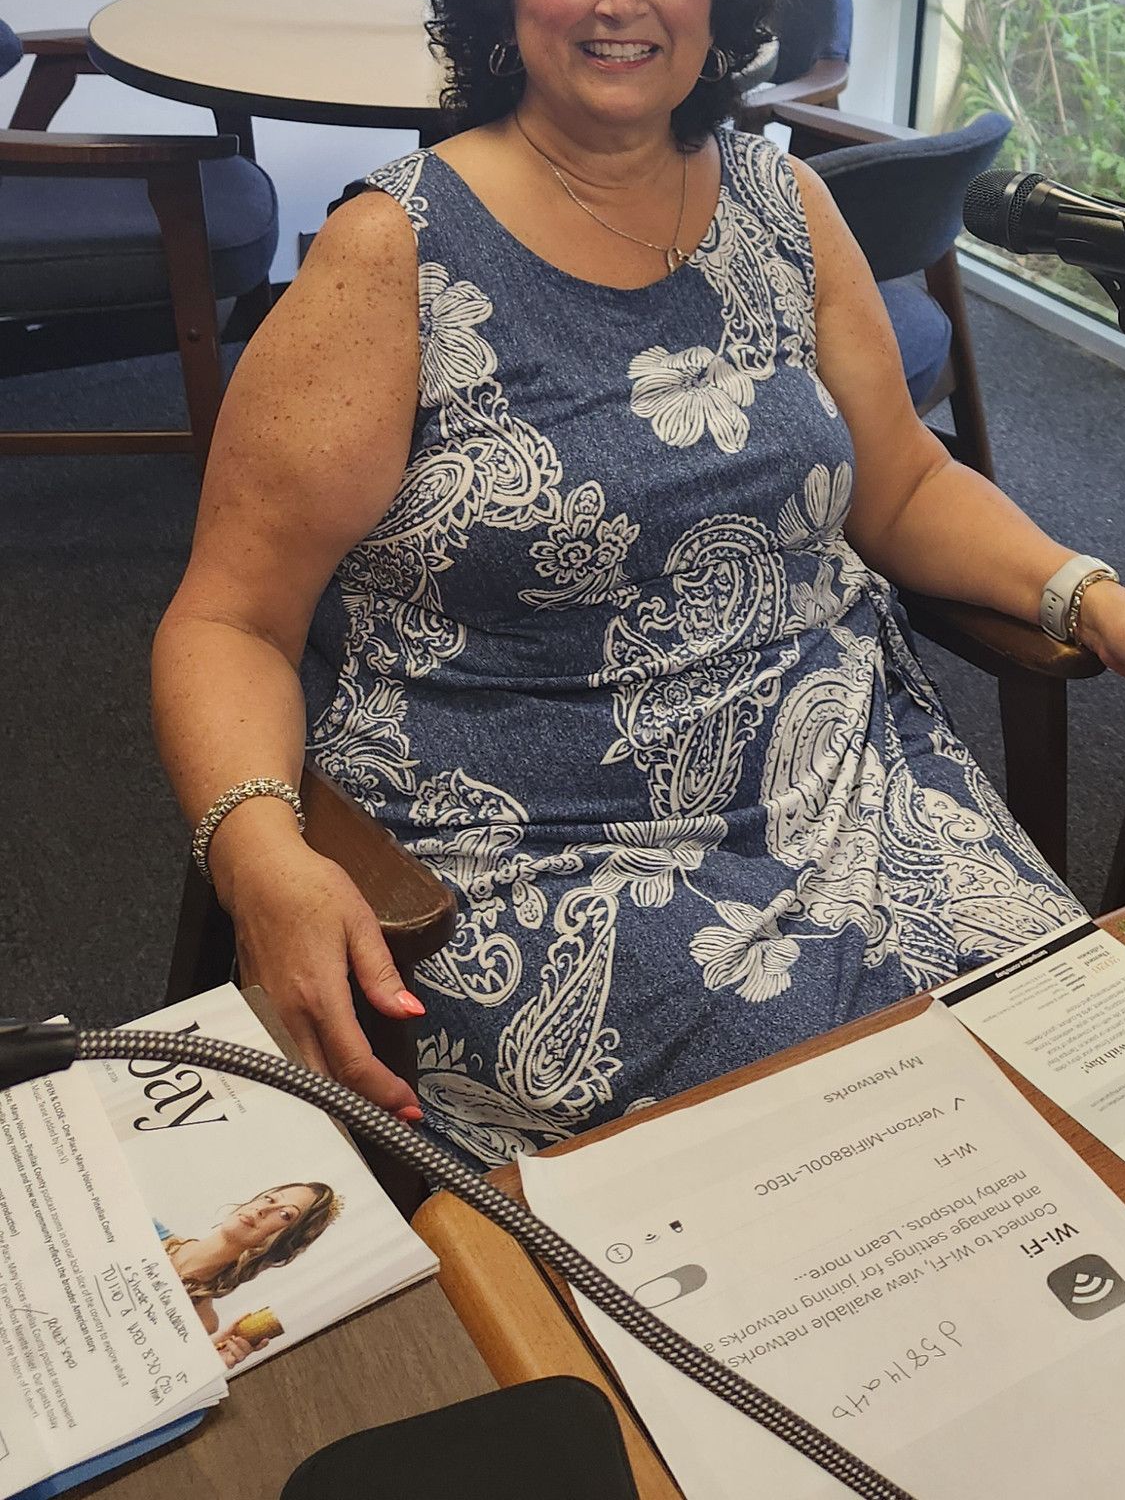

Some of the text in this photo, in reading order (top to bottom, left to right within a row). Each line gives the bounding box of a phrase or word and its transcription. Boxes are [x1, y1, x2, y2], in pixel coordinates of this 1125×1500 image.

[1078, 1054, 1107, 1073] Bay!
[42, 1079, 57, 1097] OPEN
[127, 1023, 227, 1133] bay
[823, 1056, 923, 1102] My Networks
[6, 1103, 21, 1122] Many
[51, 1100, 66, 1120] CLOSE
[13, 1120, 29, 1140] Voices
[60, 1123, 73, 1137] One
[50, 1136, 61, 1145] by
[65, 1136, 80, 1155] Place,
[751, 1102, 945, 1198] Verizon-MiFi8800L-1E0C
[22, 1143, 40, 1167] Pinellas
[72, 1153, 87, 1172] Many
[932, 1139, 977, 1169] Wi-Fi
[31, 1165, 49, 1189] County
[79, 1171, 95, 1192] Voices
[89, 1195, 107, 1221] Pinellas
[793, 1166, 1028, 1289] nearby hotspots. Learn more...
[990, 1199, 1058, 1241] Connect
[0, 1123, 98, 1353] County residents and how our community reflects the broader American story.
[60, 1237, 72, 1247] on
[99, 1220, 116, 1244] County
[973, 1232, 992, 1250] to
[1019, 1219, 1079, 1260] Wi-Fi
[63, 1245, 77, 1260] our
[923, 1238, 975, 1275] Wi-Fi,
[68, 1258, 83, 1275] local
[717, 1183, 1042, 1351] and manage settings for joining networks
[74, 1273, 89, 1289] slice
[884, 1265, 926, 1295] view
[80, 1287, 92, 1298] of
[83, 1295, 97, 1309] the
[809, 1286, 885, 1332] available
[88, 1306, 106, 1333] country
[98, 1331, 110, 1341] to
[101, 1339, 119, 1364] explore
[110, 1362, 126, 1382] what
[117, 1380, 128, 1388] it
